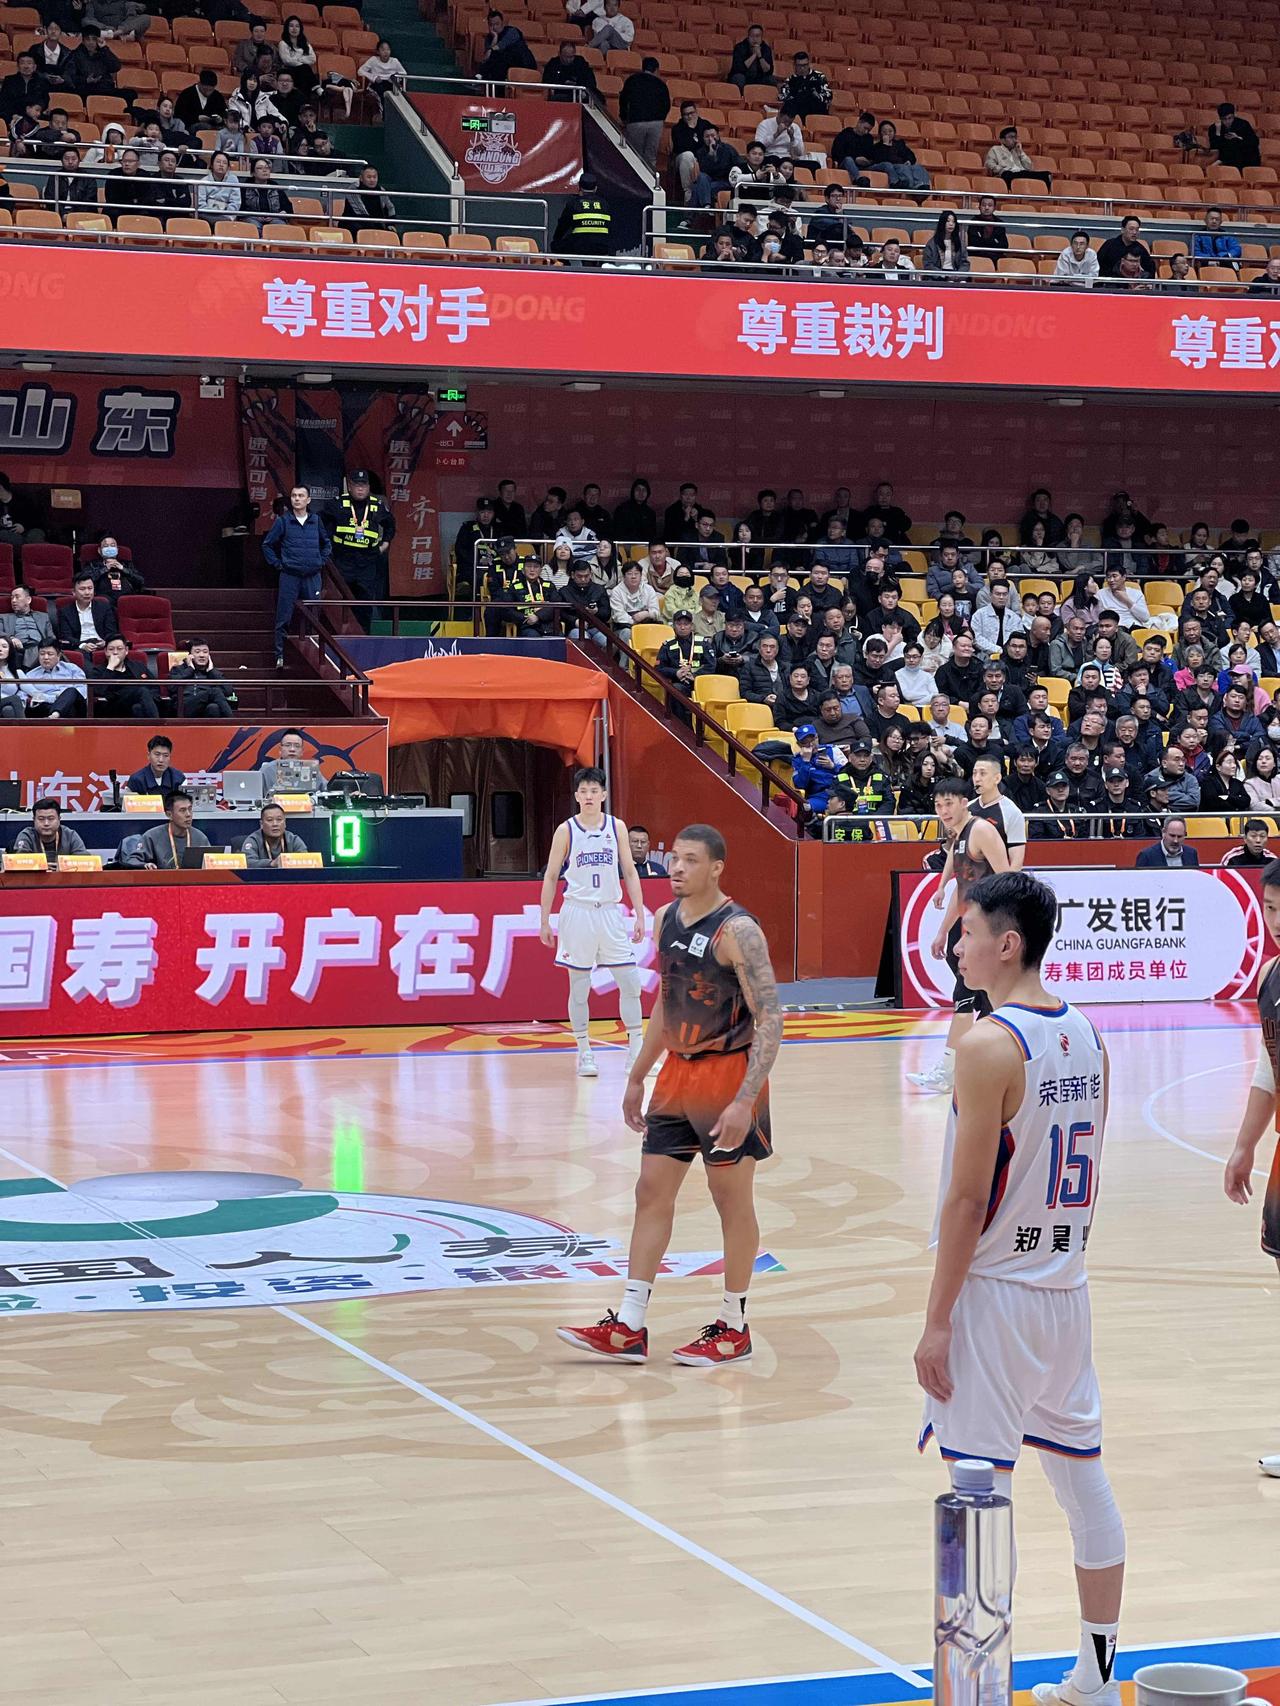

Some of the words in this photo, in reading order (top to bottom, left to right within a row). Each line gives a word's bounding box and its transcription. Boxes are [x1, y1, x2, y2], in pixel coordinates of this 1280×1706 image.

[467, 150, 519, 164] SHANDONG
[262, 278, 490, 343] 尊重对手
[484, 293, 586, 322] DONG
[737, 299, 944, 361] 尊重裁判
[1171, 315, 1280, 370] 尊重
[0, 386, 179, 455] 山东
[335, 815, 361, 857] 0
[835, 828, 863, 841] 安保
[576, 851, 614, 868] PIONEERS
[592, 873, 600, 888] 0
[1054, 897, 1187, 934] 广发银行
[0, 911, 159, 1010] 国寿
[1055, 938, 1093, 951] CHINA
[1044, 960, 1188, 982] 寿集团成员单位
[1045, 1121, 1095, 1210] 15
[1013, 1224, 1089, 1254] 郑昊
